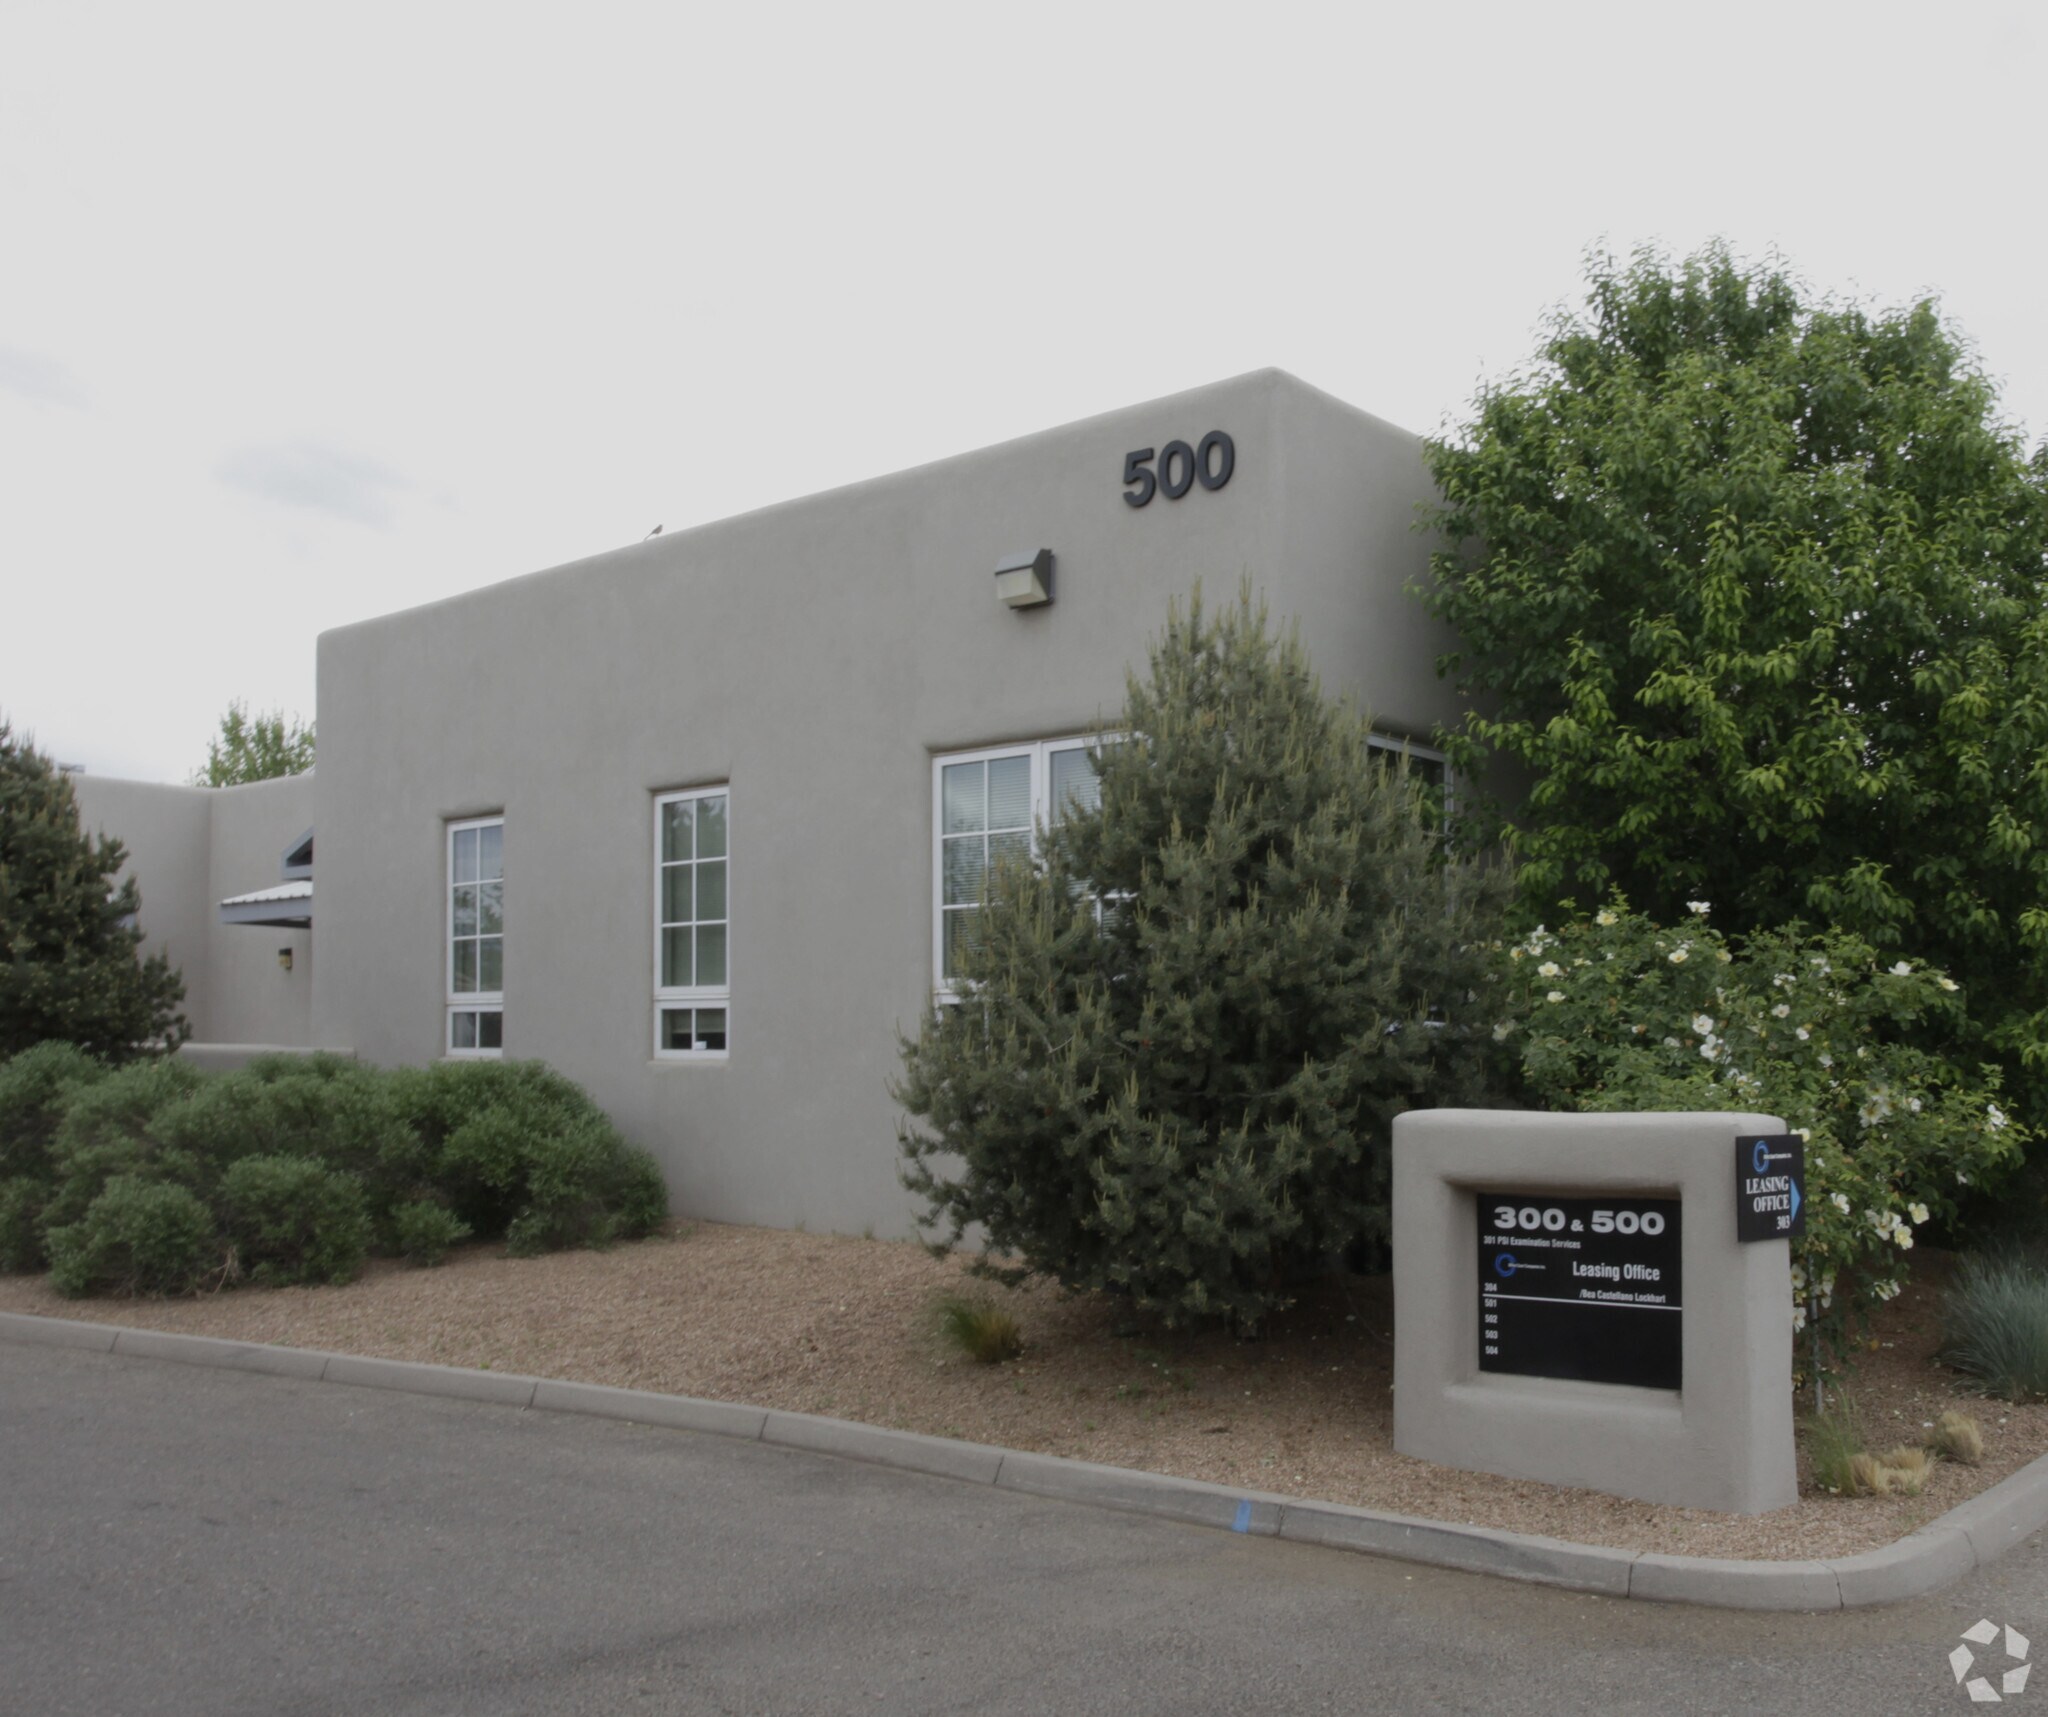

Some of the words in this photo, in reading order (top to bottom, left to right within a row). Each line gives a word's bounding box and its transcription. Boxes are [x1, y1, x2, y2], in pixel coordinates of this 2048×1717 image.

[1122, 429, 1235, 509] 500
[1746, 1176, 1789, 1195] LEASING
[1753, 1194, 1790, 1213] OFFICE
[1494, 1206, 1566, 1231] 300
[1570, 1219, 1584, 1232] &
[1591, 1210, 1665, 1235] 500
[1776, 1215, 1791, 1230] 303
[1497, 1236, 1509, 1246] PSI
[1510, 1237, 1551, 1248] Examination
[1551, 1239, 1582, 1249] Services
[1573, 1261, 1620, 1281] Leasing
[1623, 1263, 1661, 1281] Office
[1597, 1290, 1634, 1302] Castellano
[1635, 1293, 1667, 1303] Lockhart
